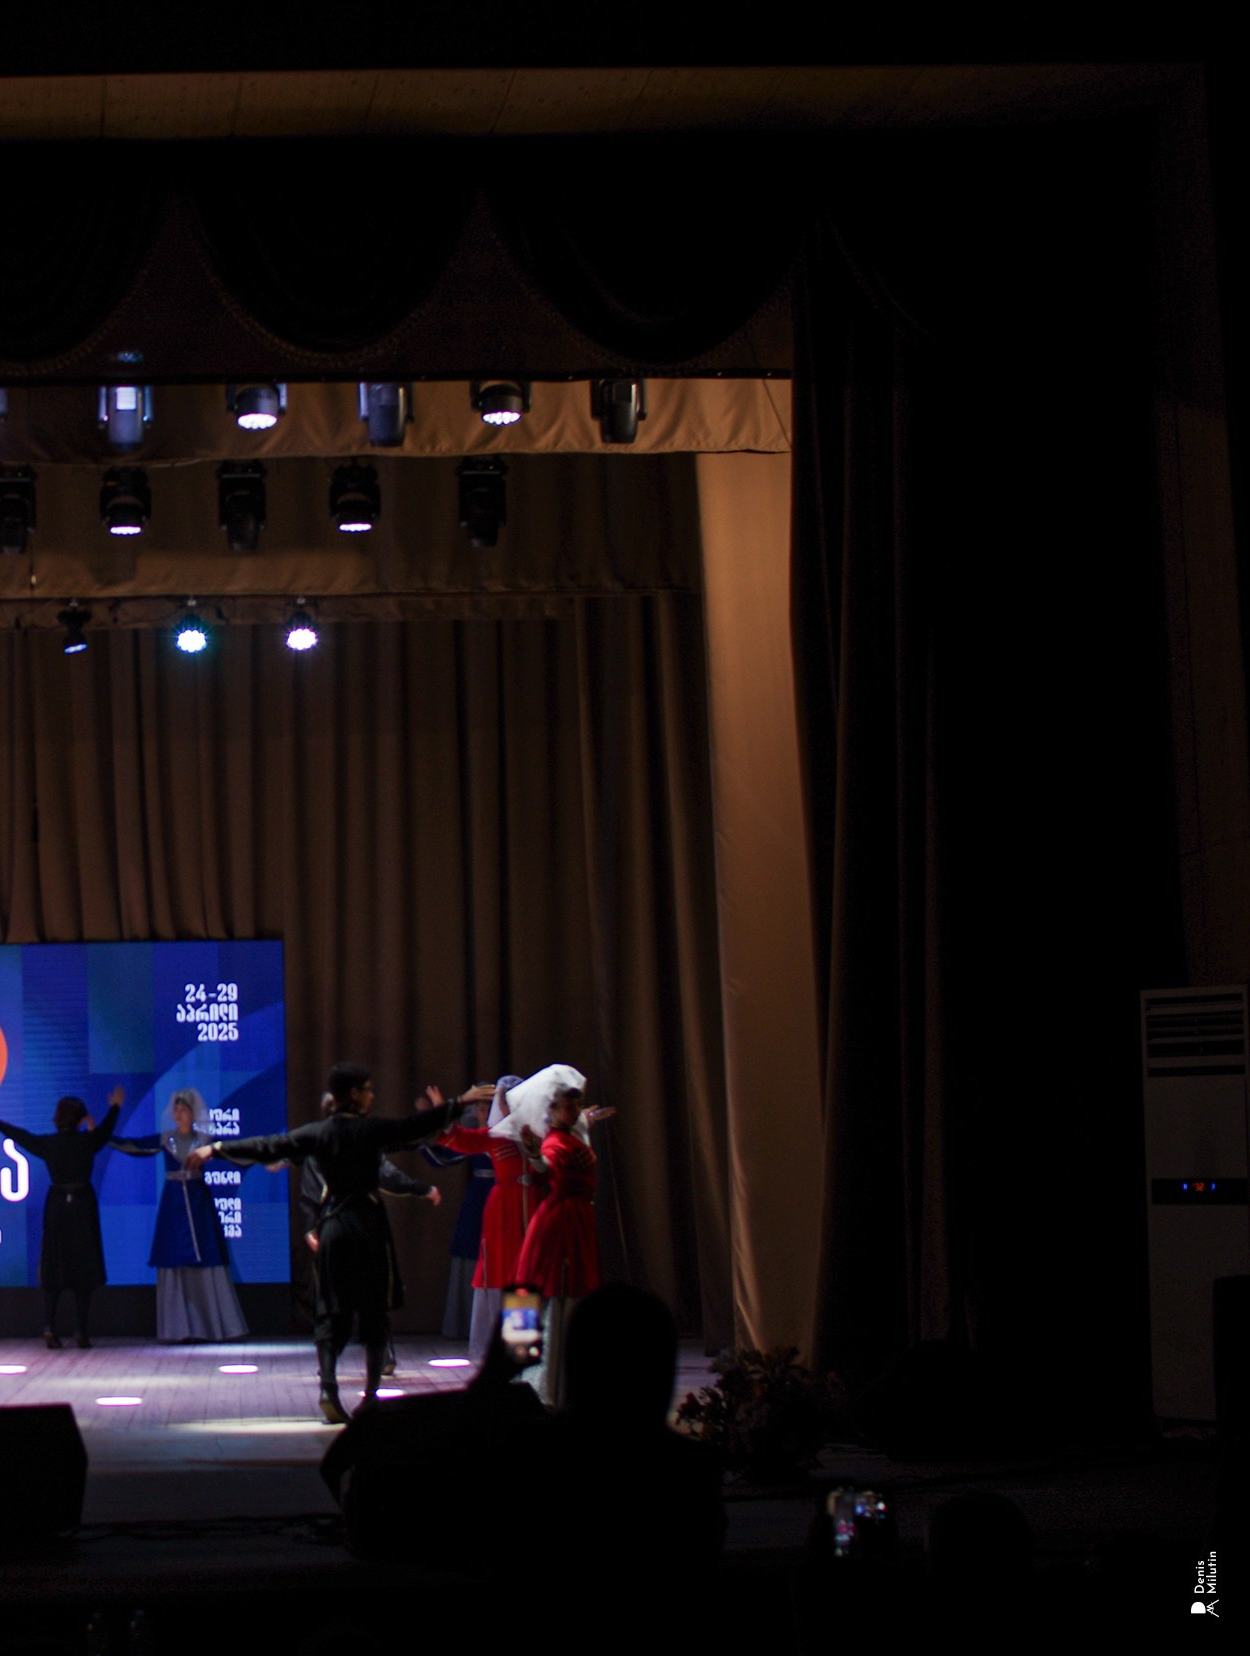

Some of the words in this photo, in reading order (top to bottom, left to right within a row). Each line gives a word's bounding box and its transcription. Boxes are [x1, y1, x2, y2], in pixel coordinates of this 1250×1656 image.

[185, 983, 238, 1002] 24-29
[176, 1003, 238, 1022] აპრილი
[197, 1022, 239, 1041] 2025
